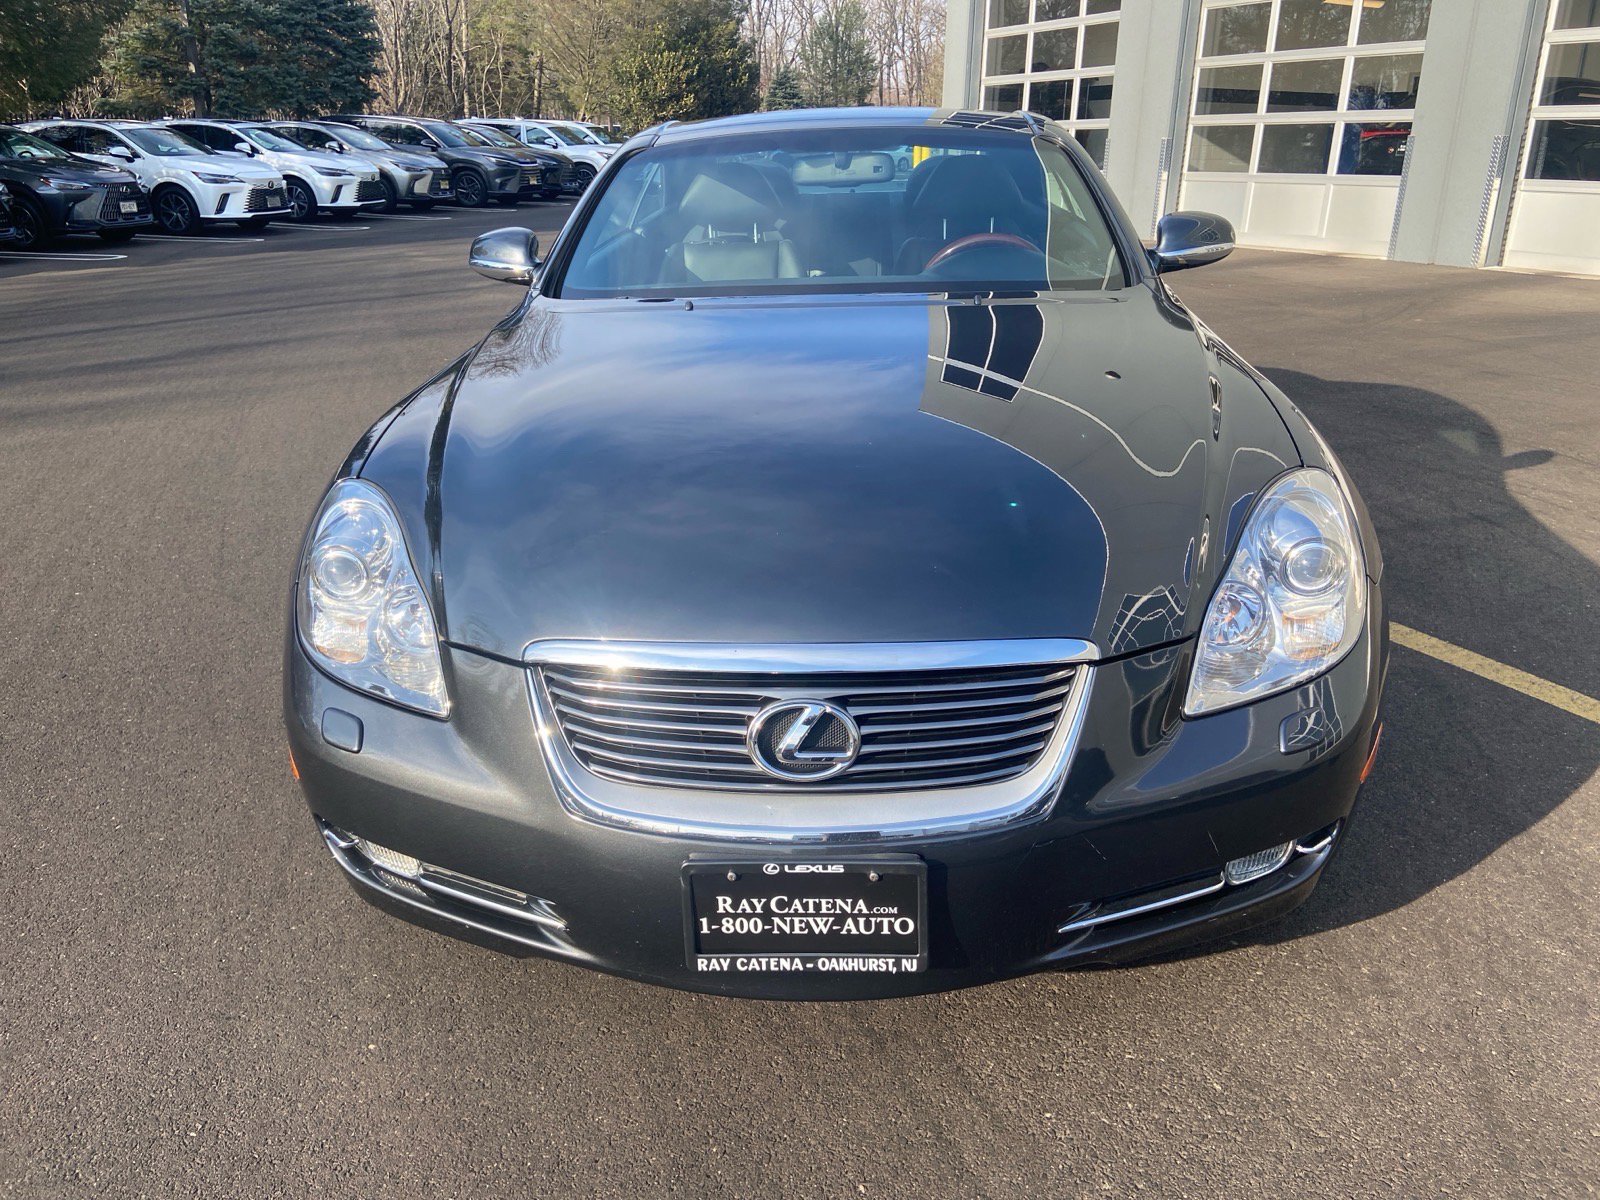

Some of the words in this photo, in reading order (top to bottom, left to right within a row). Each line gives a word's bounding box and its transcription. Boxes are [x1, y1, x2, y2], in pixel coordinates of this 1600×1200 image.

[784, 864, 845, 873] LEXUS
[716, 895, 767, 914] RAY
[700, 916, 915, 935] 1-800-NEW-AUTO
[697, 957, 731, 972] RAY
[736, 957, 804, 972] CATENA
[817, 957, 897, 975] OAKHURST,
[901, 958, 918, 972] NJ
